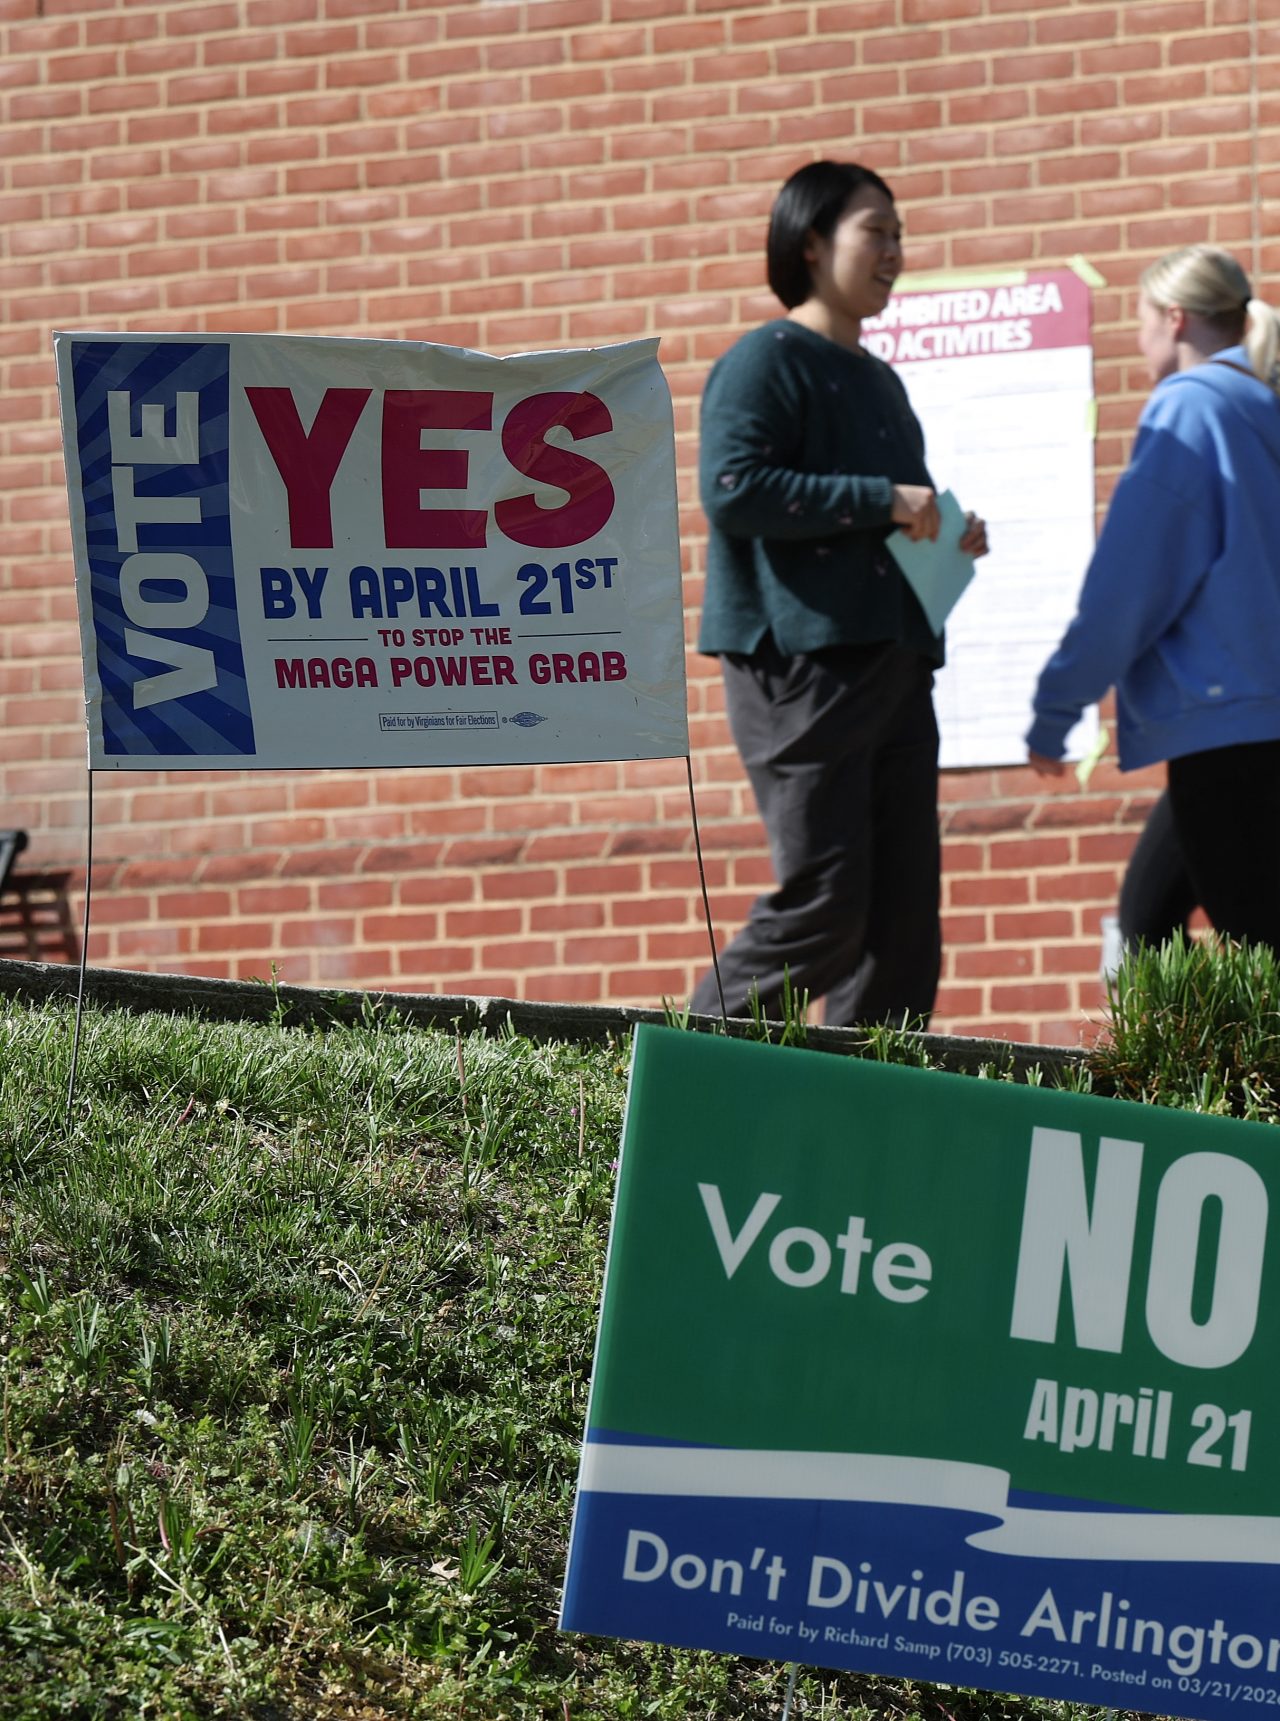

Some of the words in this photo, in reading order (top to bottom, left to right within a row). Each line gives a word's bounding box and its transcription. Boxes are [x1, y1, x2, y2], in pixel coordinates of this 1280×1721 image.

[990, 282, 1063, 318] AREA
[897, 318, 1033, 361] ACTIVITIES
[244, 386, 616, 550] YES
[108, 390, 219, 710] VOTE
[259, 567, 328, 619] BY
[349, 565, 501, 619] APRIL
[516, 557, 619, 616] 21ST
[274, 657, 379, 689] MAGA
[390, 655, 518, 688] POWER
[528, 651, 628, 683] GRAB
[377, 629, 405, 647] TO
[412, 628, 465, 647] STOP
[470, 627, 512, 645] THE
[382, 716, 397, 727] Paid
[397, 716, 406, 726] for
[407, 716, 415, 728] by
[416, 715, 446, 728] Virginians
[446, 715, 455, 726] for
[456, 715, 467, 726] Fair
[468, 714, 496, 725] Elections
[696, 1182, 934, 1305] Vote
[1009, 1125, 1270, 1370] NO
[1022, 1379, 1173, 1461] April
[1187, 1402, 1253, 1472] 21
[621, 1528, 787, 1602] Don't
[806, 1554, 1001, 1632] Divide
[726, 1612, 763, 1632] Paid
[768, 1616, 793, 1636] for
[798, 1620, 819, 1643] by
[823, 1625, 889, 1649] Richard
[894, 1635, 942, 1661] Samp
[946, 1641, 993, 1668] (703)
[997, 1650, 1085, 1678] 505-2271.
[1090, 1663, 1147, 1687] Posted
[1151, 1676, 1173, 1690] on
